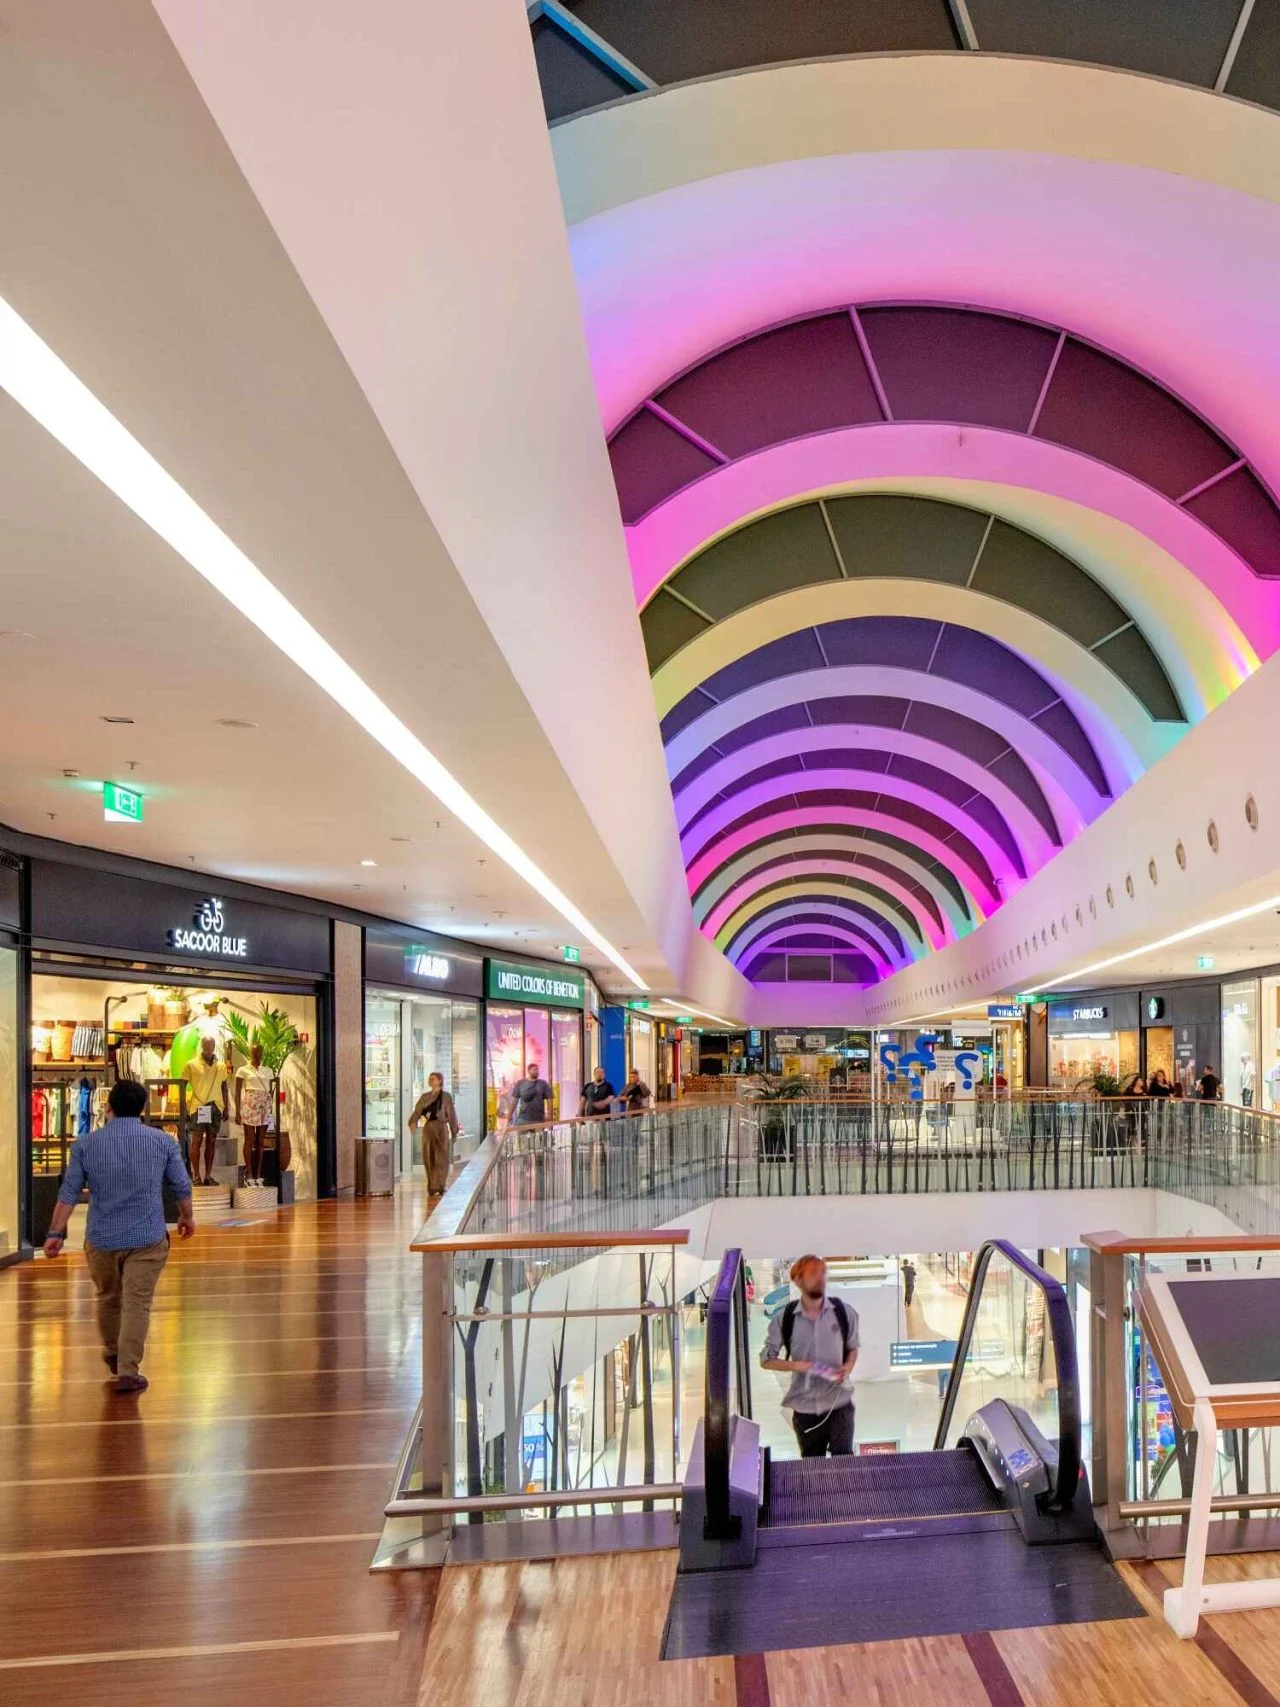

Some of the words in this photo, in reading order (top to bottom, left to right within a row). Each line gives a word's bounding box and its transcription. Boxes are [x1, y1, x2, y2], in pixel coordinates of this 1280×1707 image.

[174, 928, 220, 953] SACOOR
[222, 936, 247, 957] BLUE
[498, 971, 521, 991] UNITED
[522, 975, 545, 995] COLORS
[545, 979, 554, 996] OF
[1073, 1007, 1104, 1020] STARBUCKS
